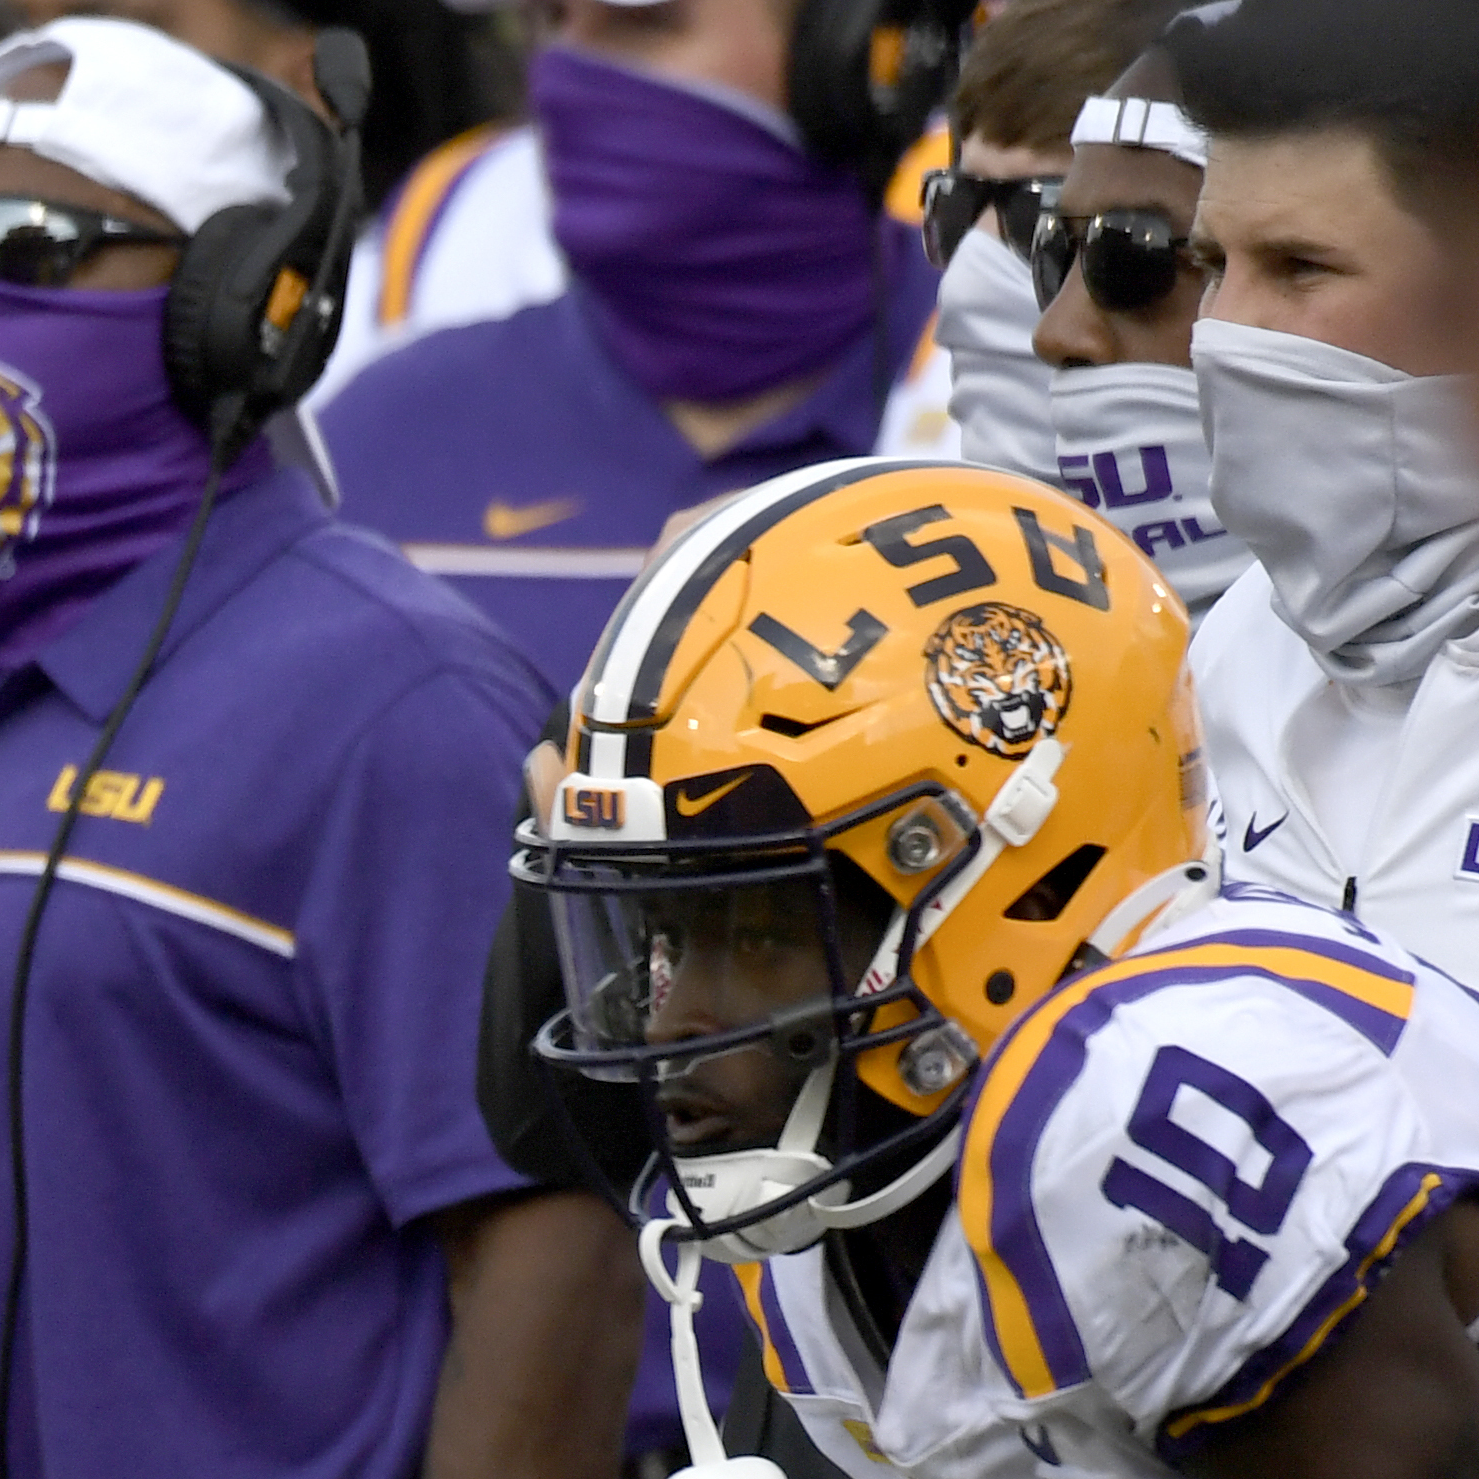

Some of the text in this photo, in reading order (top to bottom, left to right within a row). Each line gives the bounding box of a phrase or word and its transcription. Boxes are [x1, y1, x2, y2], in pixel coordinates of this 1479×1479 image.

[45, 763, 166, 824] LSU
[563, 785, 627, 830] LSU
[1098, 1045, 1315, 1304] 10
